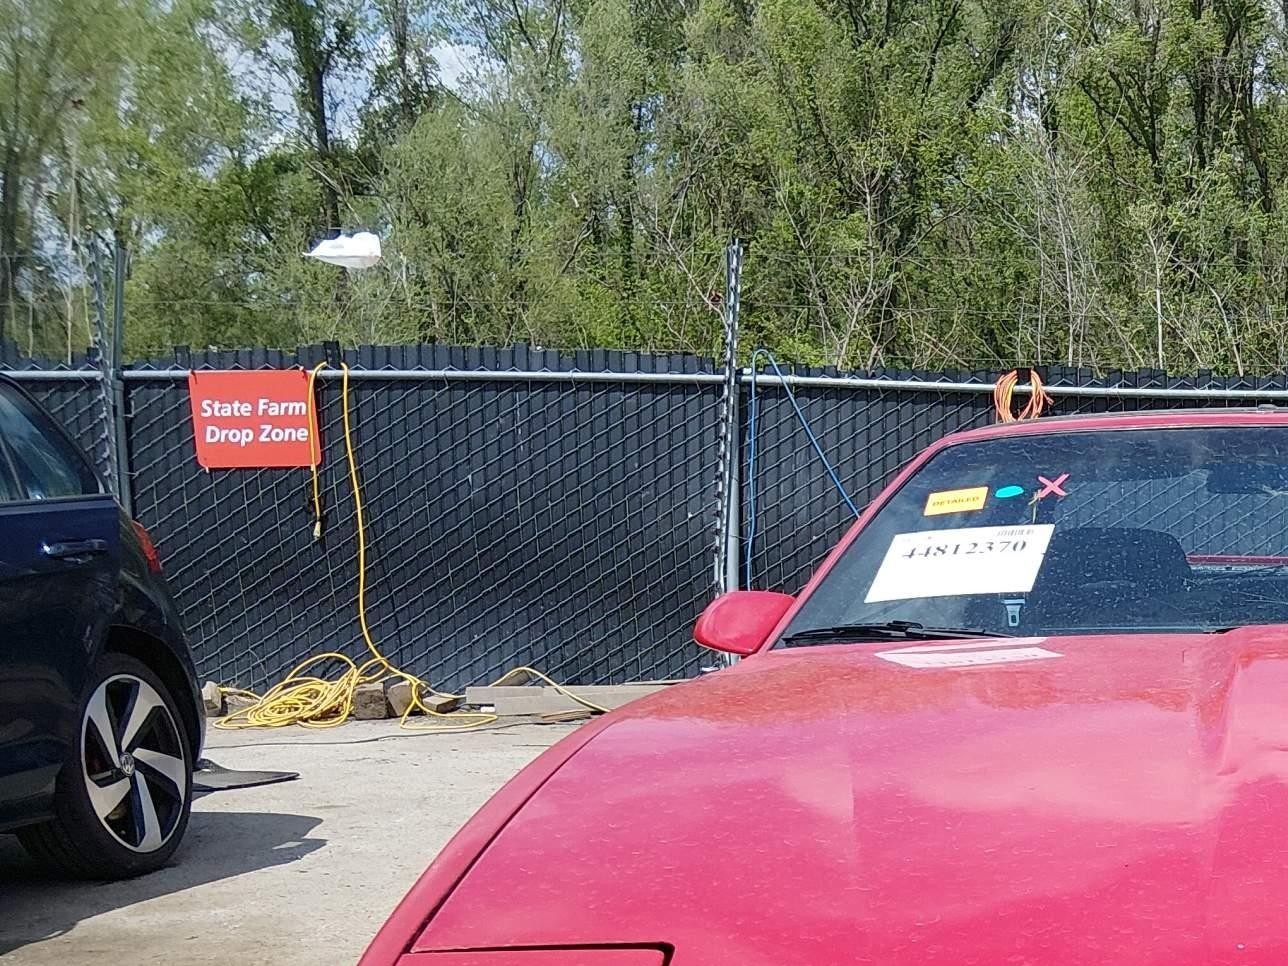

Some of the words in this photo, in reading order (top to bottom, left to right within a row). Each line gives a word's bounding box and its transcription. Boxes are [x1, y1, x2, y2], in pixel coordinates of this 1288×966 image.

[201, 399, 252, 417] State
[257, 398, 307, 416] Farm
[205, 425, 254, 447] Drop
[258, 424, 309, 442] Zone
[902, 540, 1028, 559] 44812370
